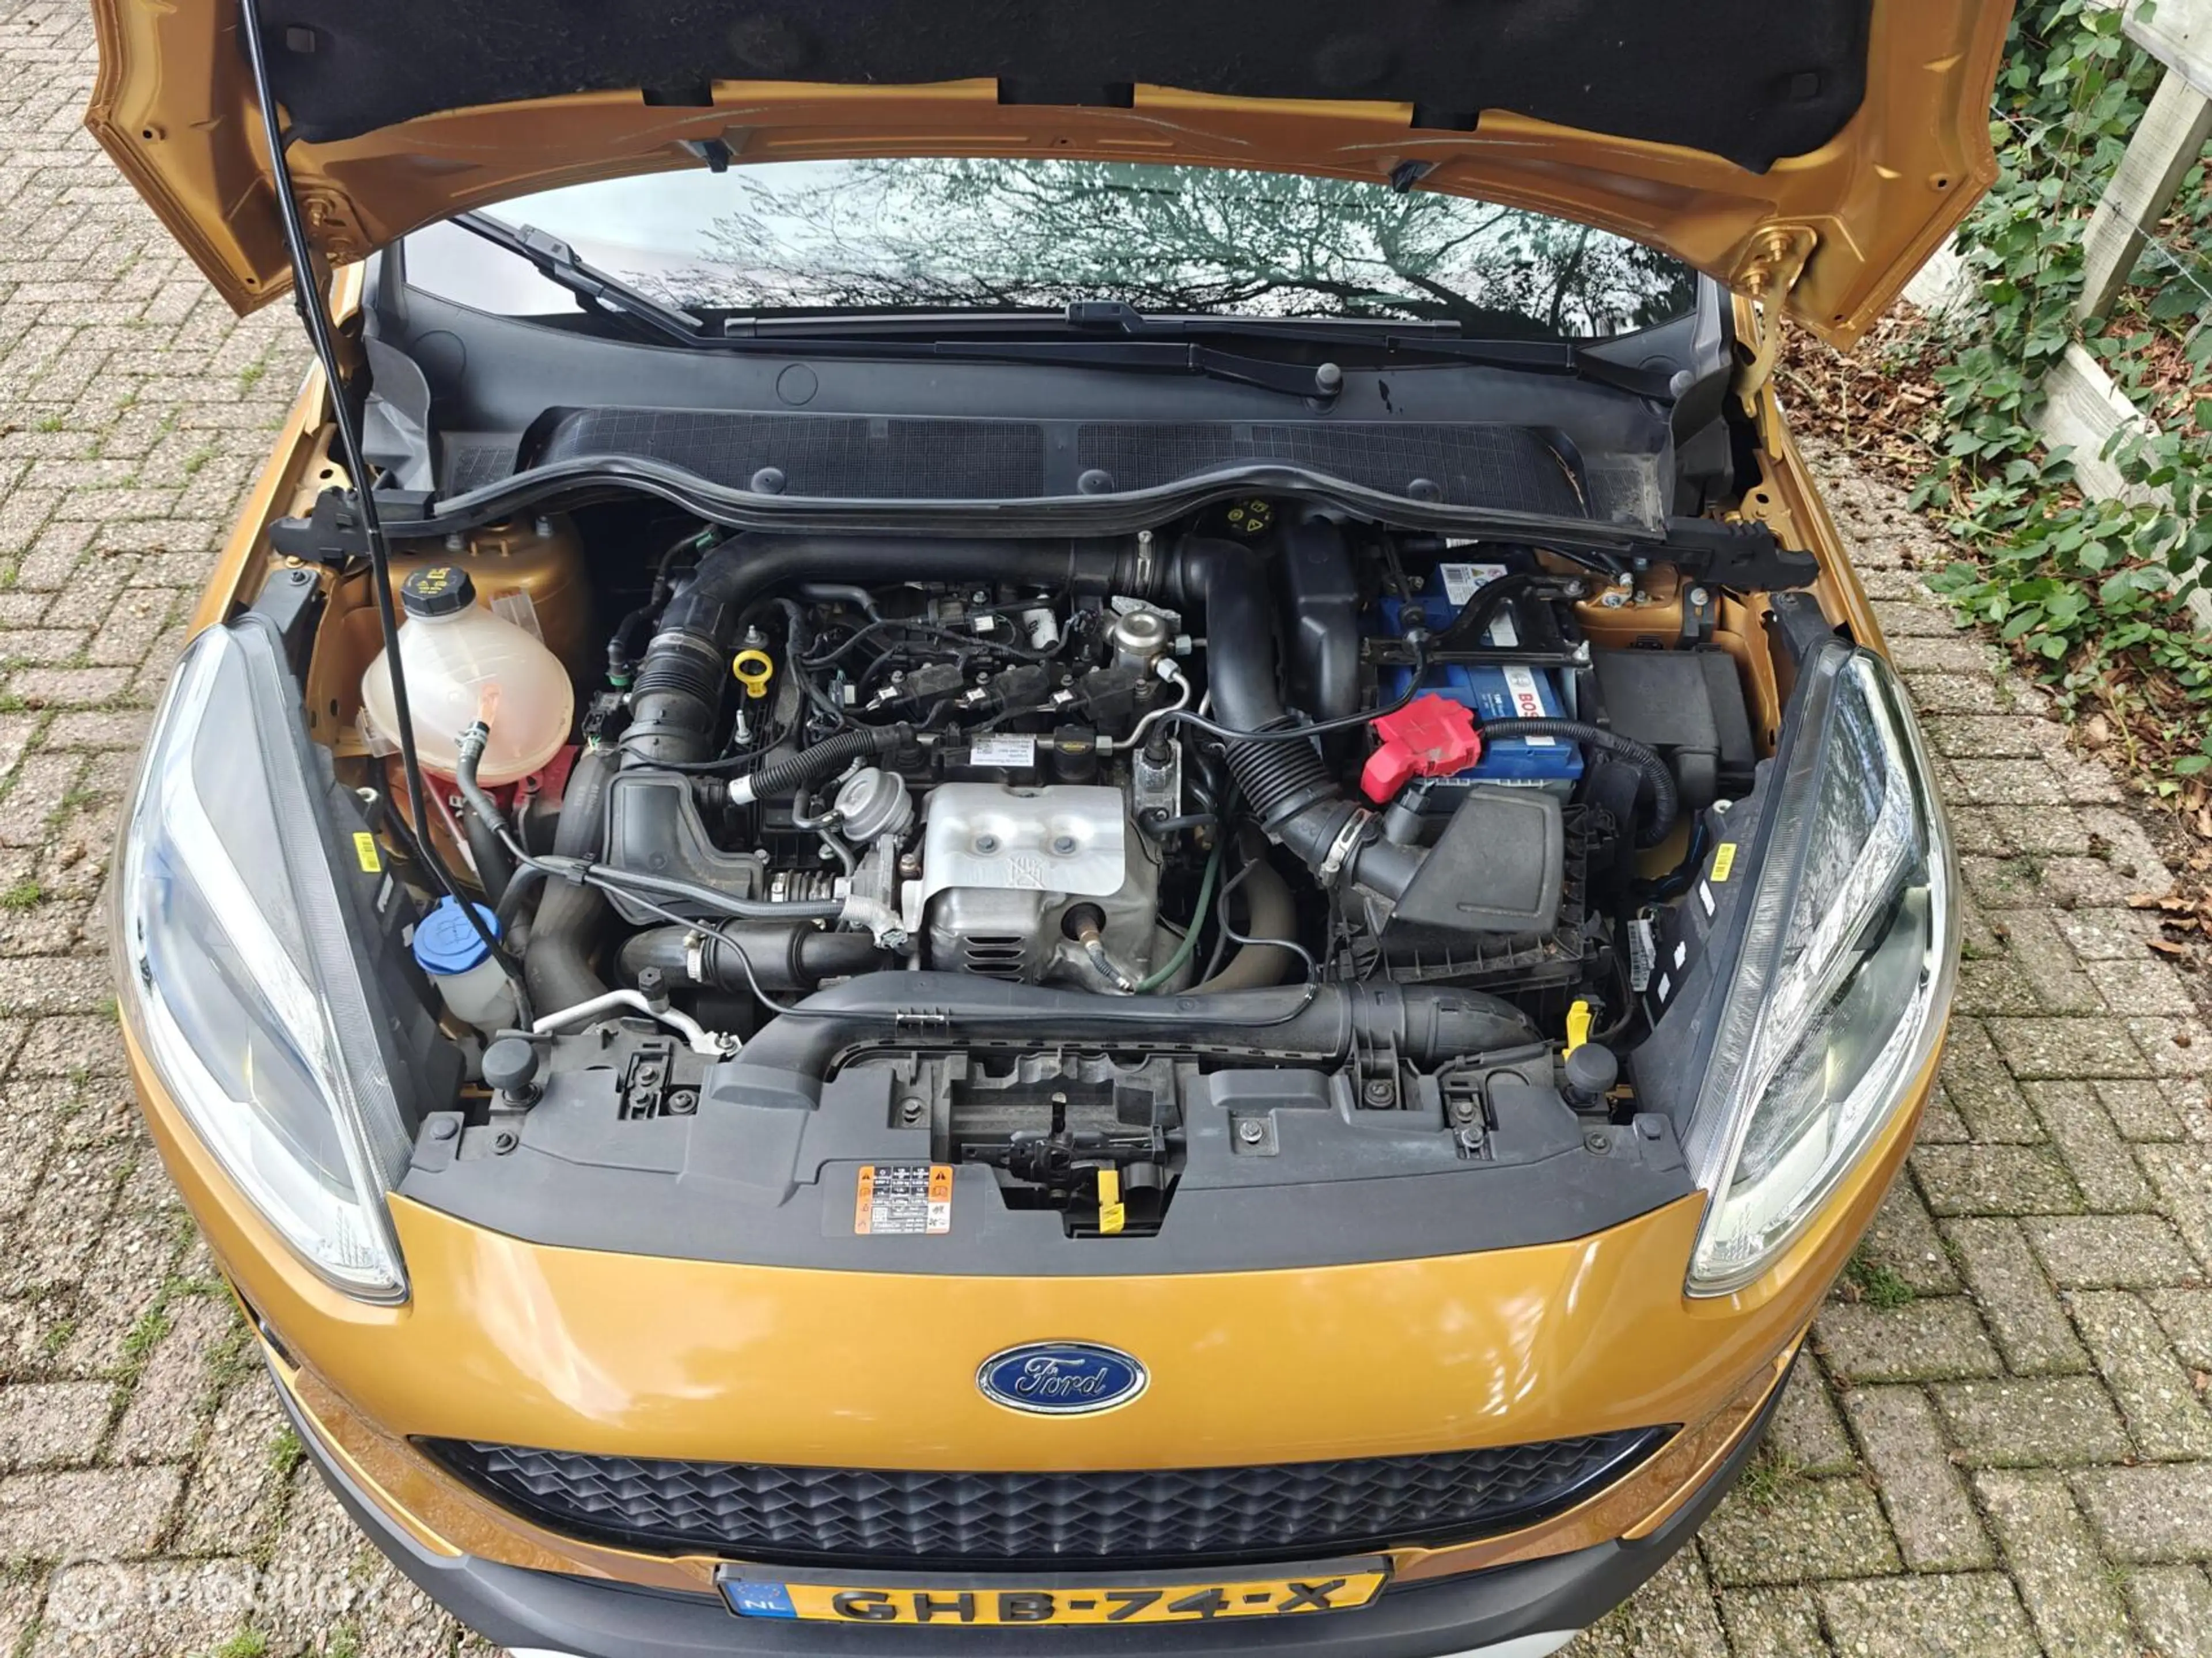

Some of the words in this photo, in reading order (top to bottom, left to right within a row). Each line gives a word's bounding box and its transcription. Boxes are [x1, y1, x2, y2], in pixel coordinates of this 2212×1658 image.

[1518, 693, 1539, 718] BOS
[1014, 1356, 1109, 1397] Ford
[744, 1599, 787, 1610] NL
[831, 1578, 1346, 1623] GHB-74-X
